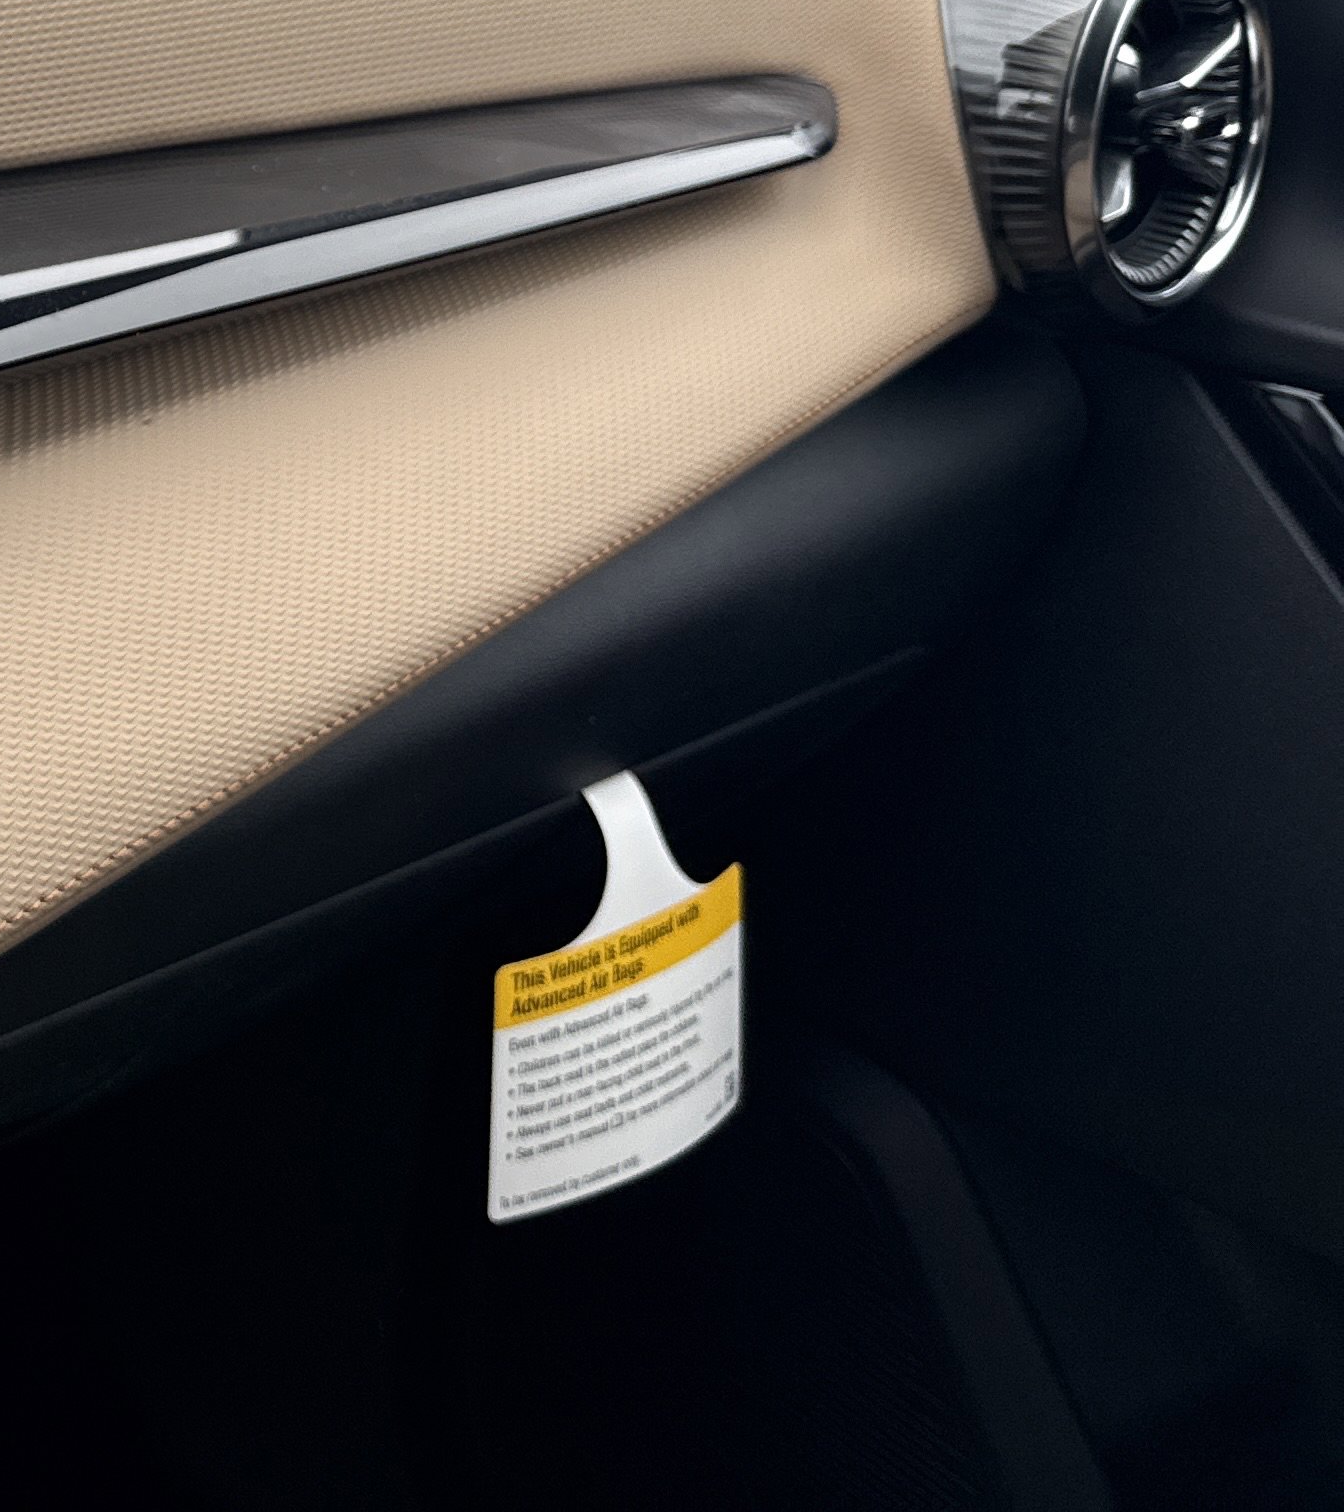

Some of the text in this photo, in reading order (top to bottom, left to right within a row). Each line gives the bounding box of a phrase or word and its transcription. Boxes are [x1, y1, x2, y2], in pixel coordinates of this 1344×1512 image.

[513, 902, 699, 993] This Vehicle is Equipped with
[511, 958, 644, 1018] Advanced Air Bags
